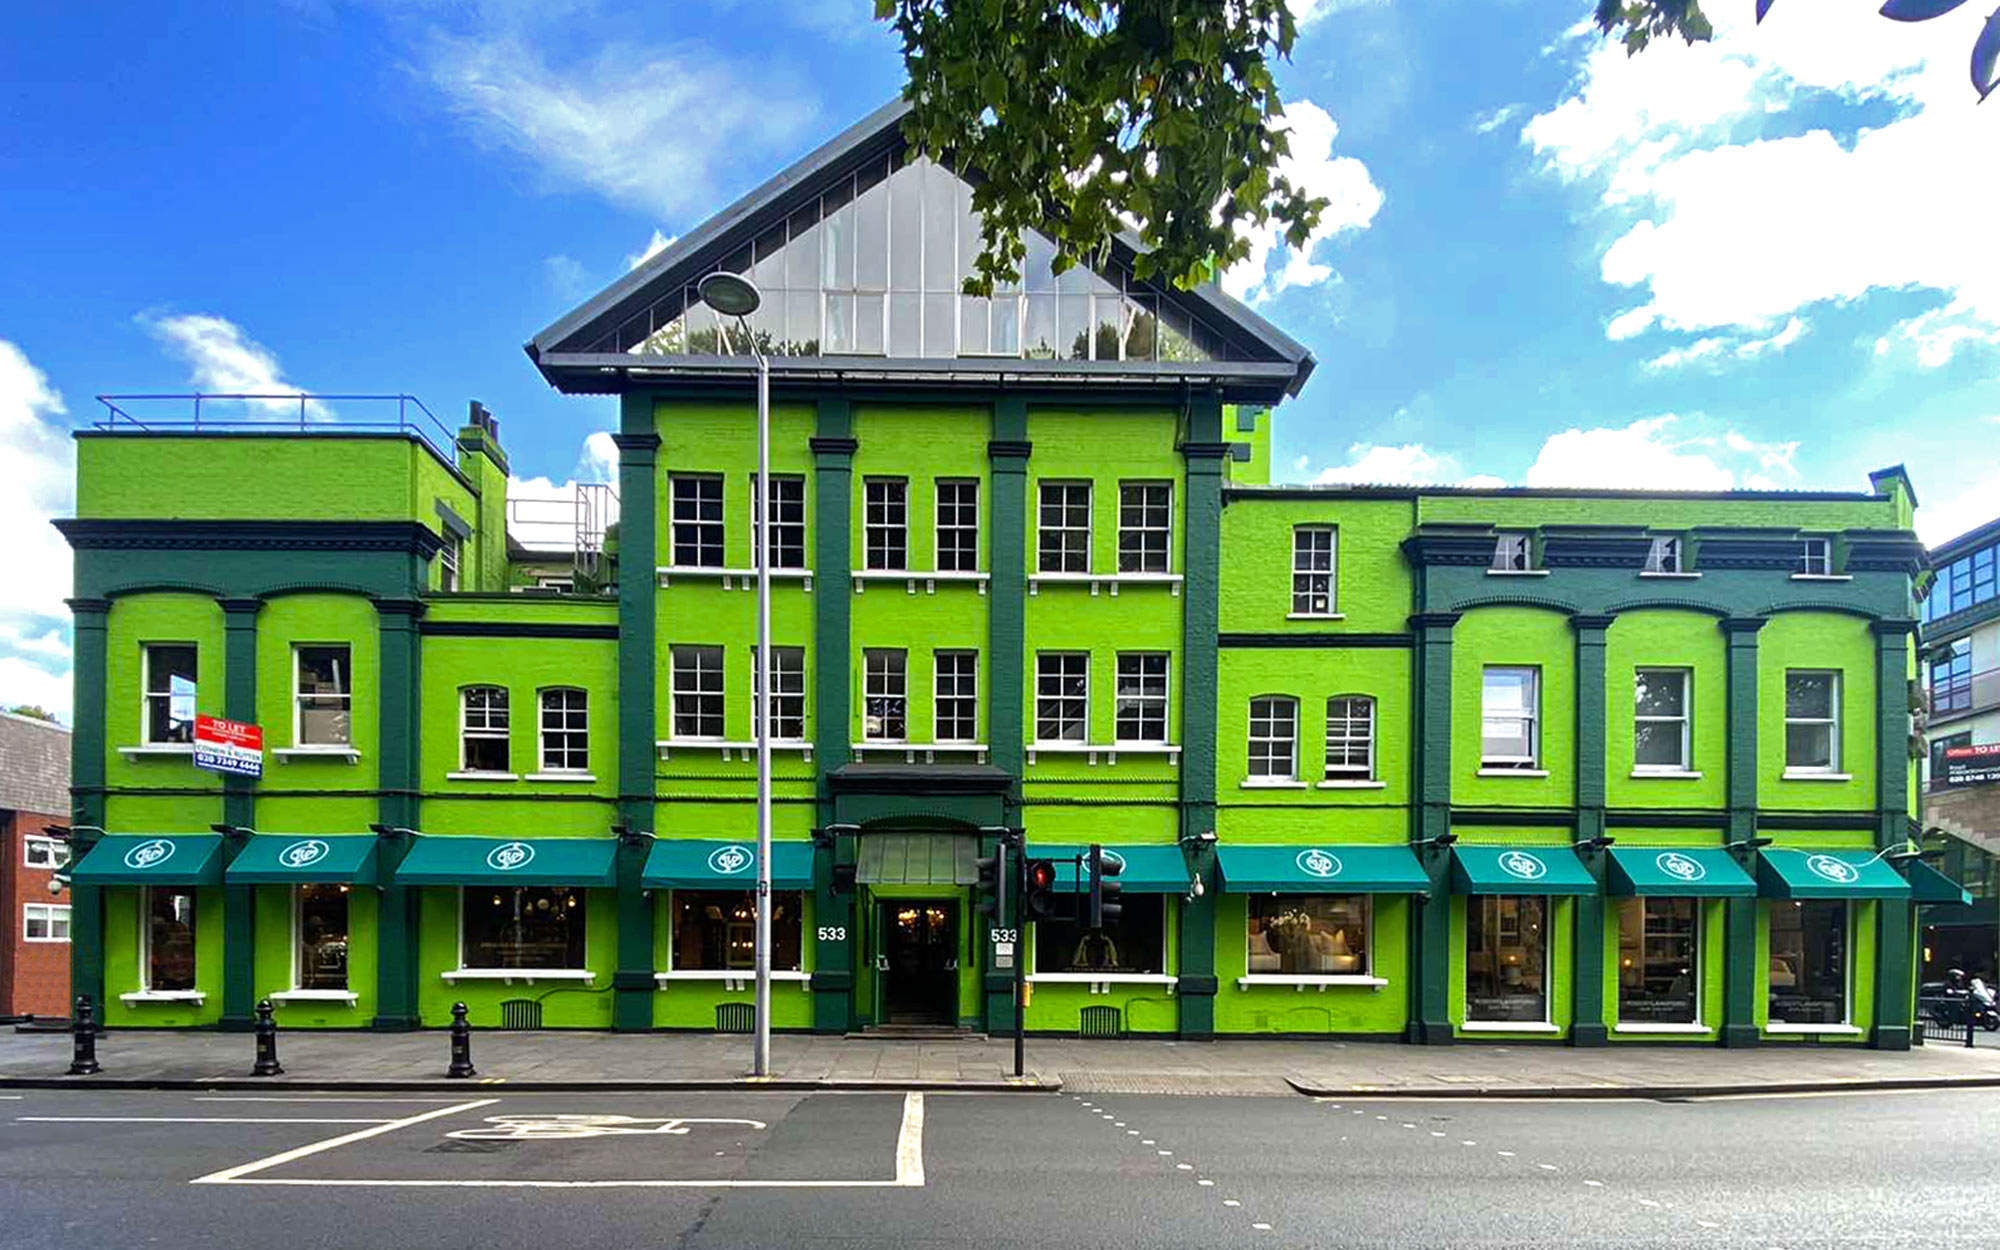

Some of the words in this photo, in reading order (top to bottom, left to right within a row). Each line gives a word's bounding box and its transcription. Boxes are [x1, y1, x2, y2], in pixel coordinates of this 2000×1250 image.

[212, 719, 226, 729] TO
[228, 722, 246, 732] LET
[1975, 746, 1988, 755] TO
[197, 753, 215, 763] 020
[818, 927, 846, 941] 533
[991, 928, 1017, 942] 533
